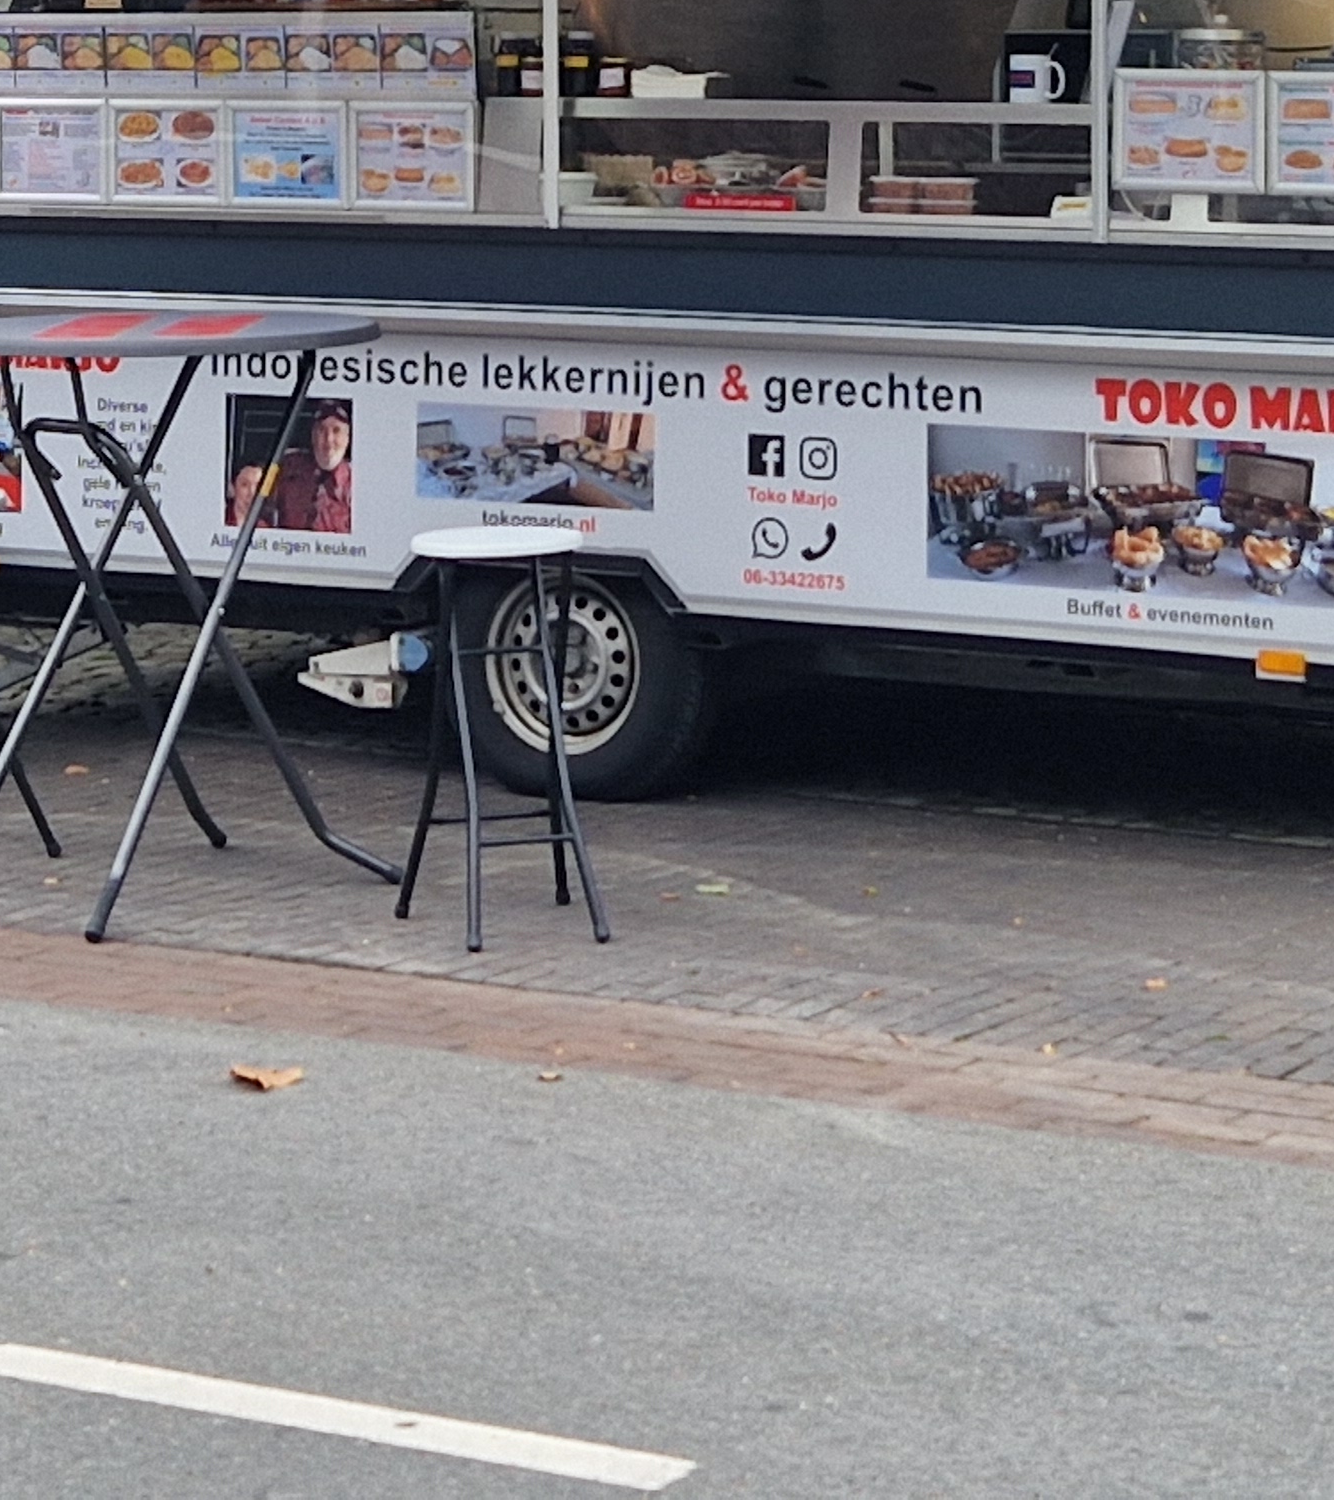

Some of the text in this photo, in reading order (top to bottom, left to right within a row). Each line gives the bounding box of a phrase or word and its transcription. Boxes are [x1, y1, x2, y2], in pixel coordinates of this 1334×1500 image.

[211, 348, 984, 414] Indoesische lekkernijen & gerechten
[97, 397, 149, 414] Diverse
[1094, 377, 1239, 430] TOKO
[747, 486, 838, 511] Toko Marjo
[482, 508, 596, 533] tokomarjonl
[271, 537, 311, 556] eigen
[315, 540, 367, 558] keuken
[1067, 598, 1275, 631] Buffet & evenementen
